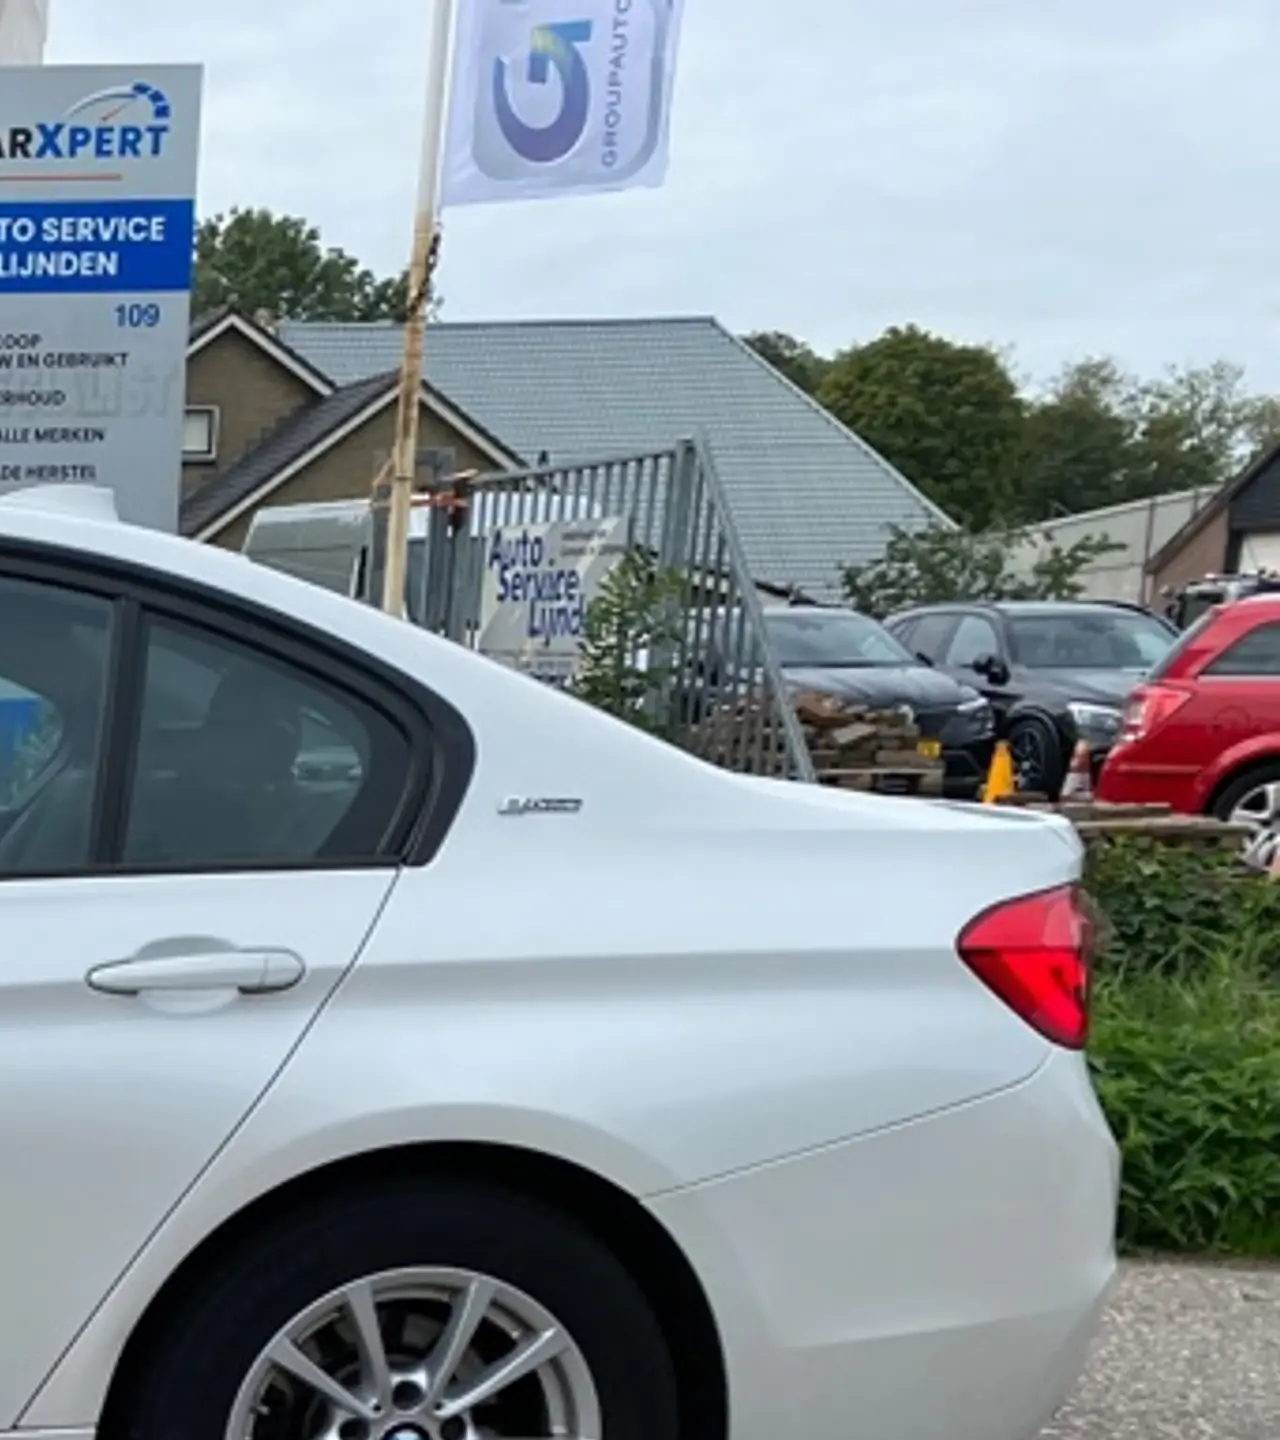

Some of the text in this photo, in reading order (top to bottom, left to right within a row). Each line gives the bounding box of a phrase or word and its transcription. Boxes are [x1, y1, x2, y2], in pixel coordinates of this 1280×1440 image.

[41, 215, 167, 243] SERVICE
[114, 304, 161, 328] 109
[17, 352, 40, 368] EN
[42, 352, 130, 368] GEBRUIKT
[34, 427, 106, 443] MERKEN
[25, 464, 98, 481] HERSTEL
[489, 529, 544, 570] Auto
